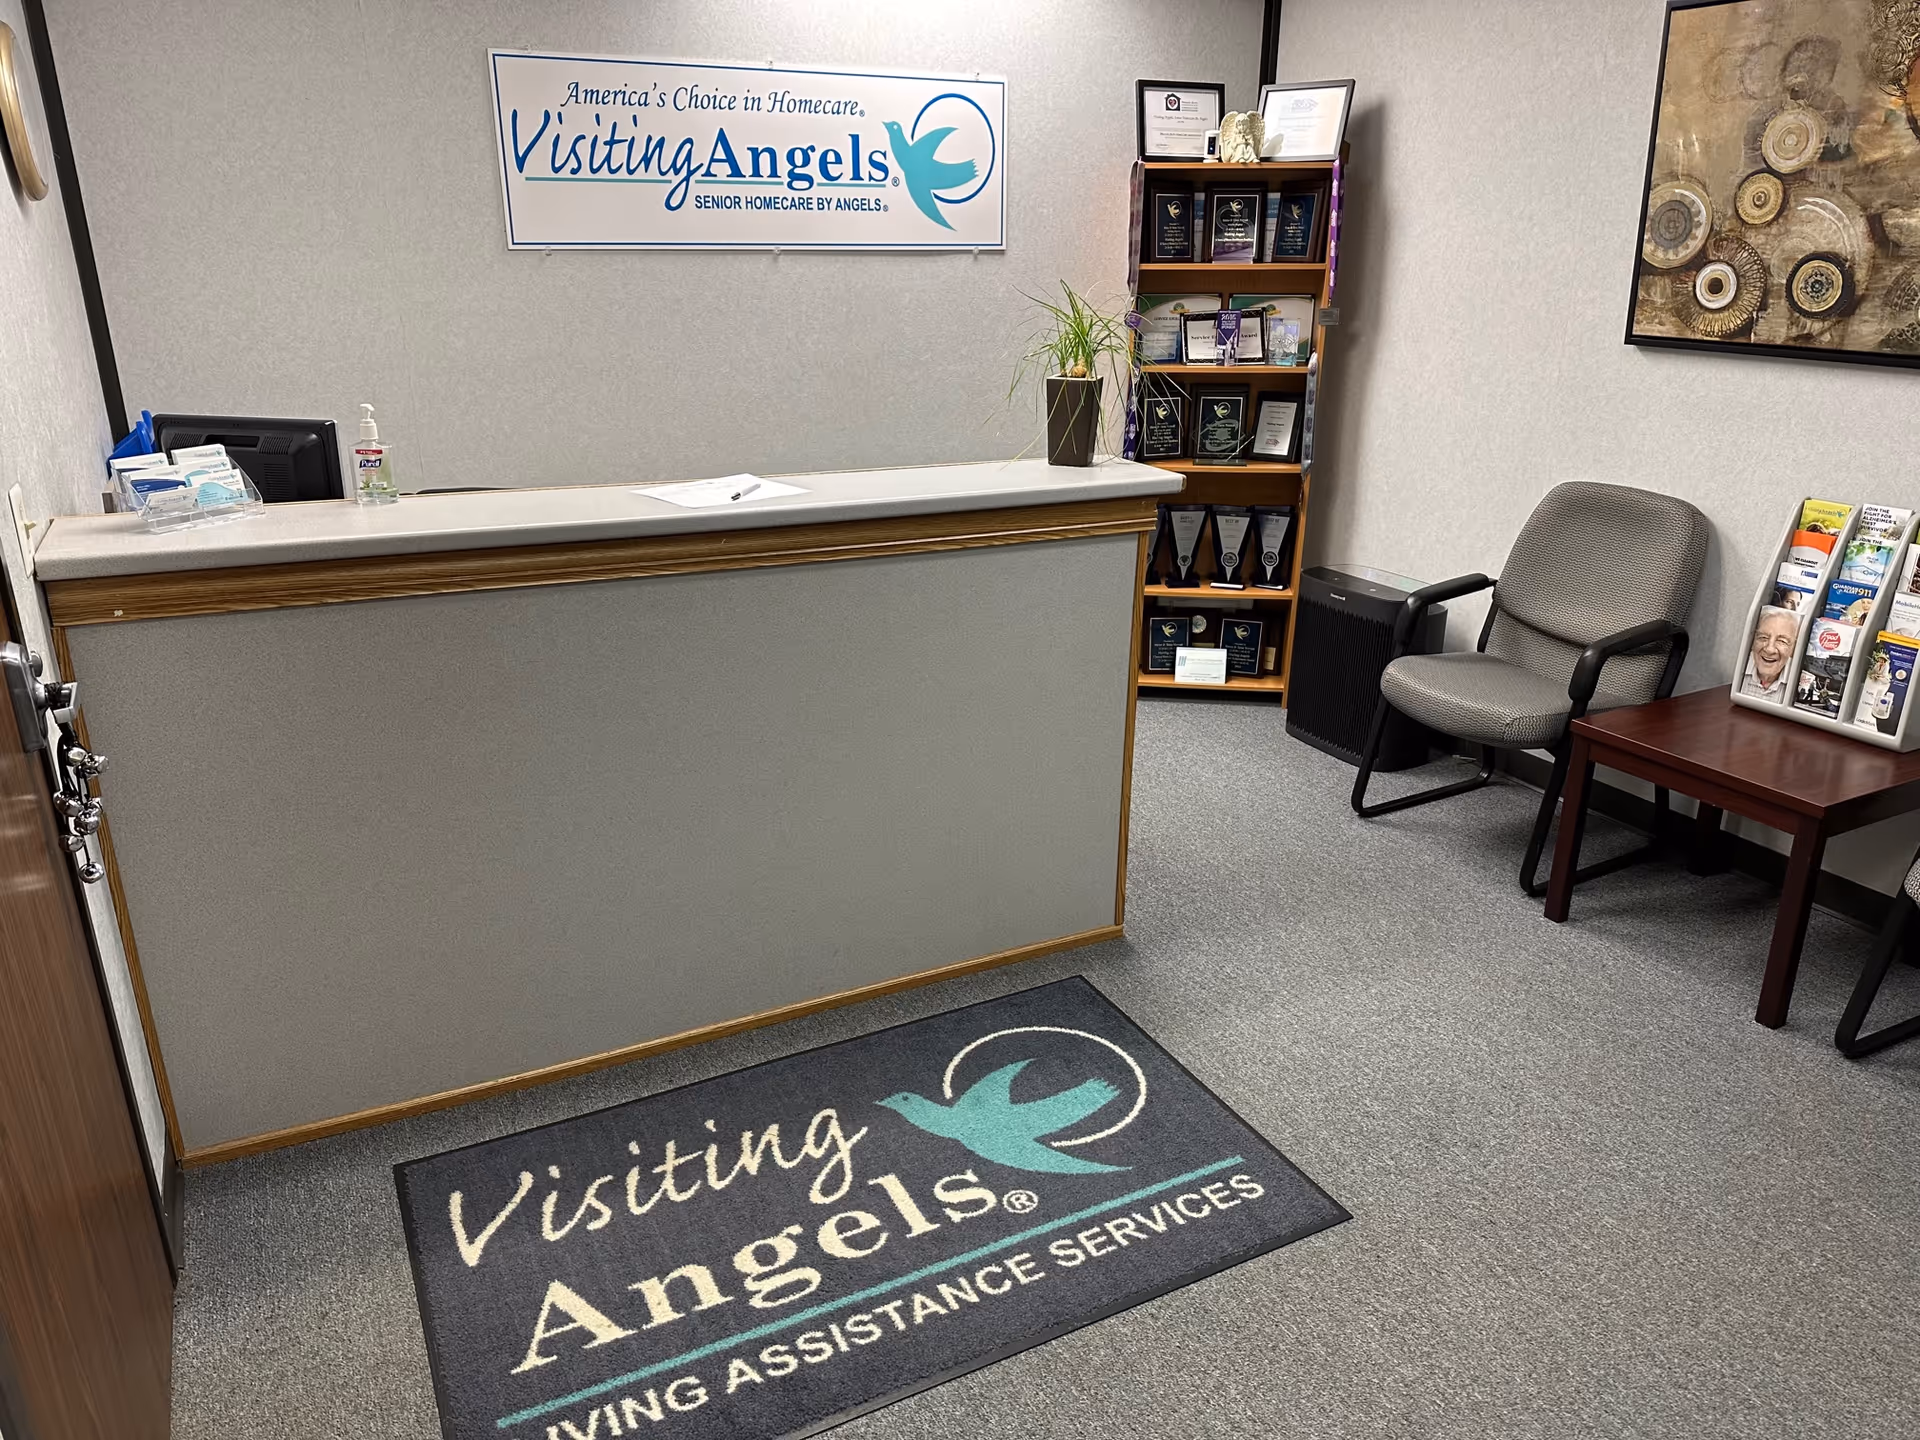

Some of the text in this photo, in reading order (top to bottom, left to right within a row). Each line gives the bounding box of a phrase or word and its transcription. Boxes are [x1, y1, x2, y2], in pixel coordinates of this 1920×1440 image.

[559, 81, 667, 108] America's
[673, 84, 737, 112] Choice
[742, 91, 762, 112] in
[511, 108, 704, 212] Visiting
[694, 194, 742, 210] SENIOR
[745, 195, 814, 211] HOMECARE
[817, 197, 833, 211] BY
[1858, 588, 1872, 597] 911
[448, 1107, 868, 1268] Visiting
[512, 1174, 1266, 1440] VING ASSISTANCE SERVICES
